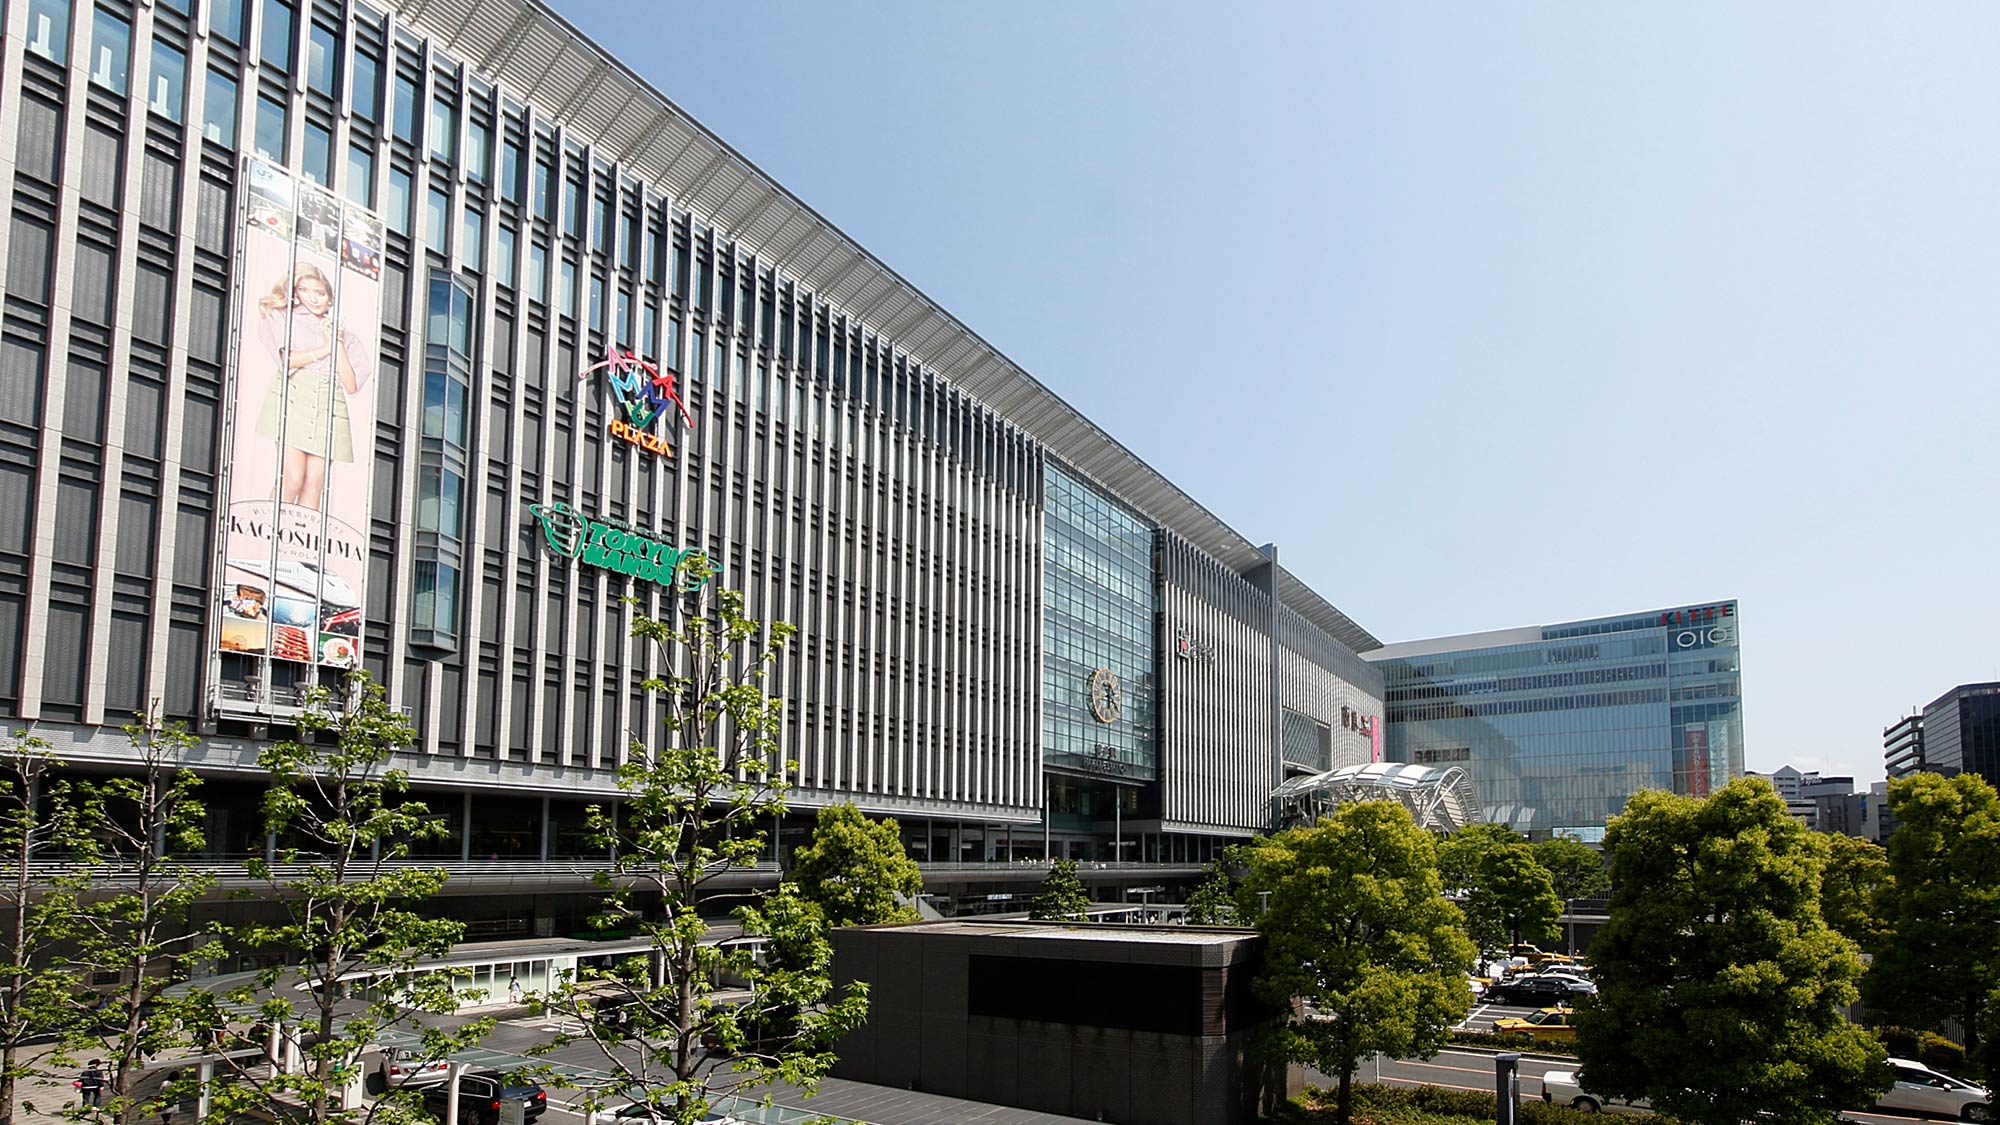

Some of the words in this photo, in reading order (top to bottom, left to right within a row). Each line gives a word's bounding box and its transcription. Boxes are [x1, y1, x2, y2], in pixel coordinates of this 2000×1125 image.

[610, 418, 673, 458] PLAZA
[230, 515, 362, 562] KAGOSHIMA
[589, 521, 679, 567] TOKYU
[583, 542, 673, 586] HANDS
[1661, 603, 1734, 626] KITTE
